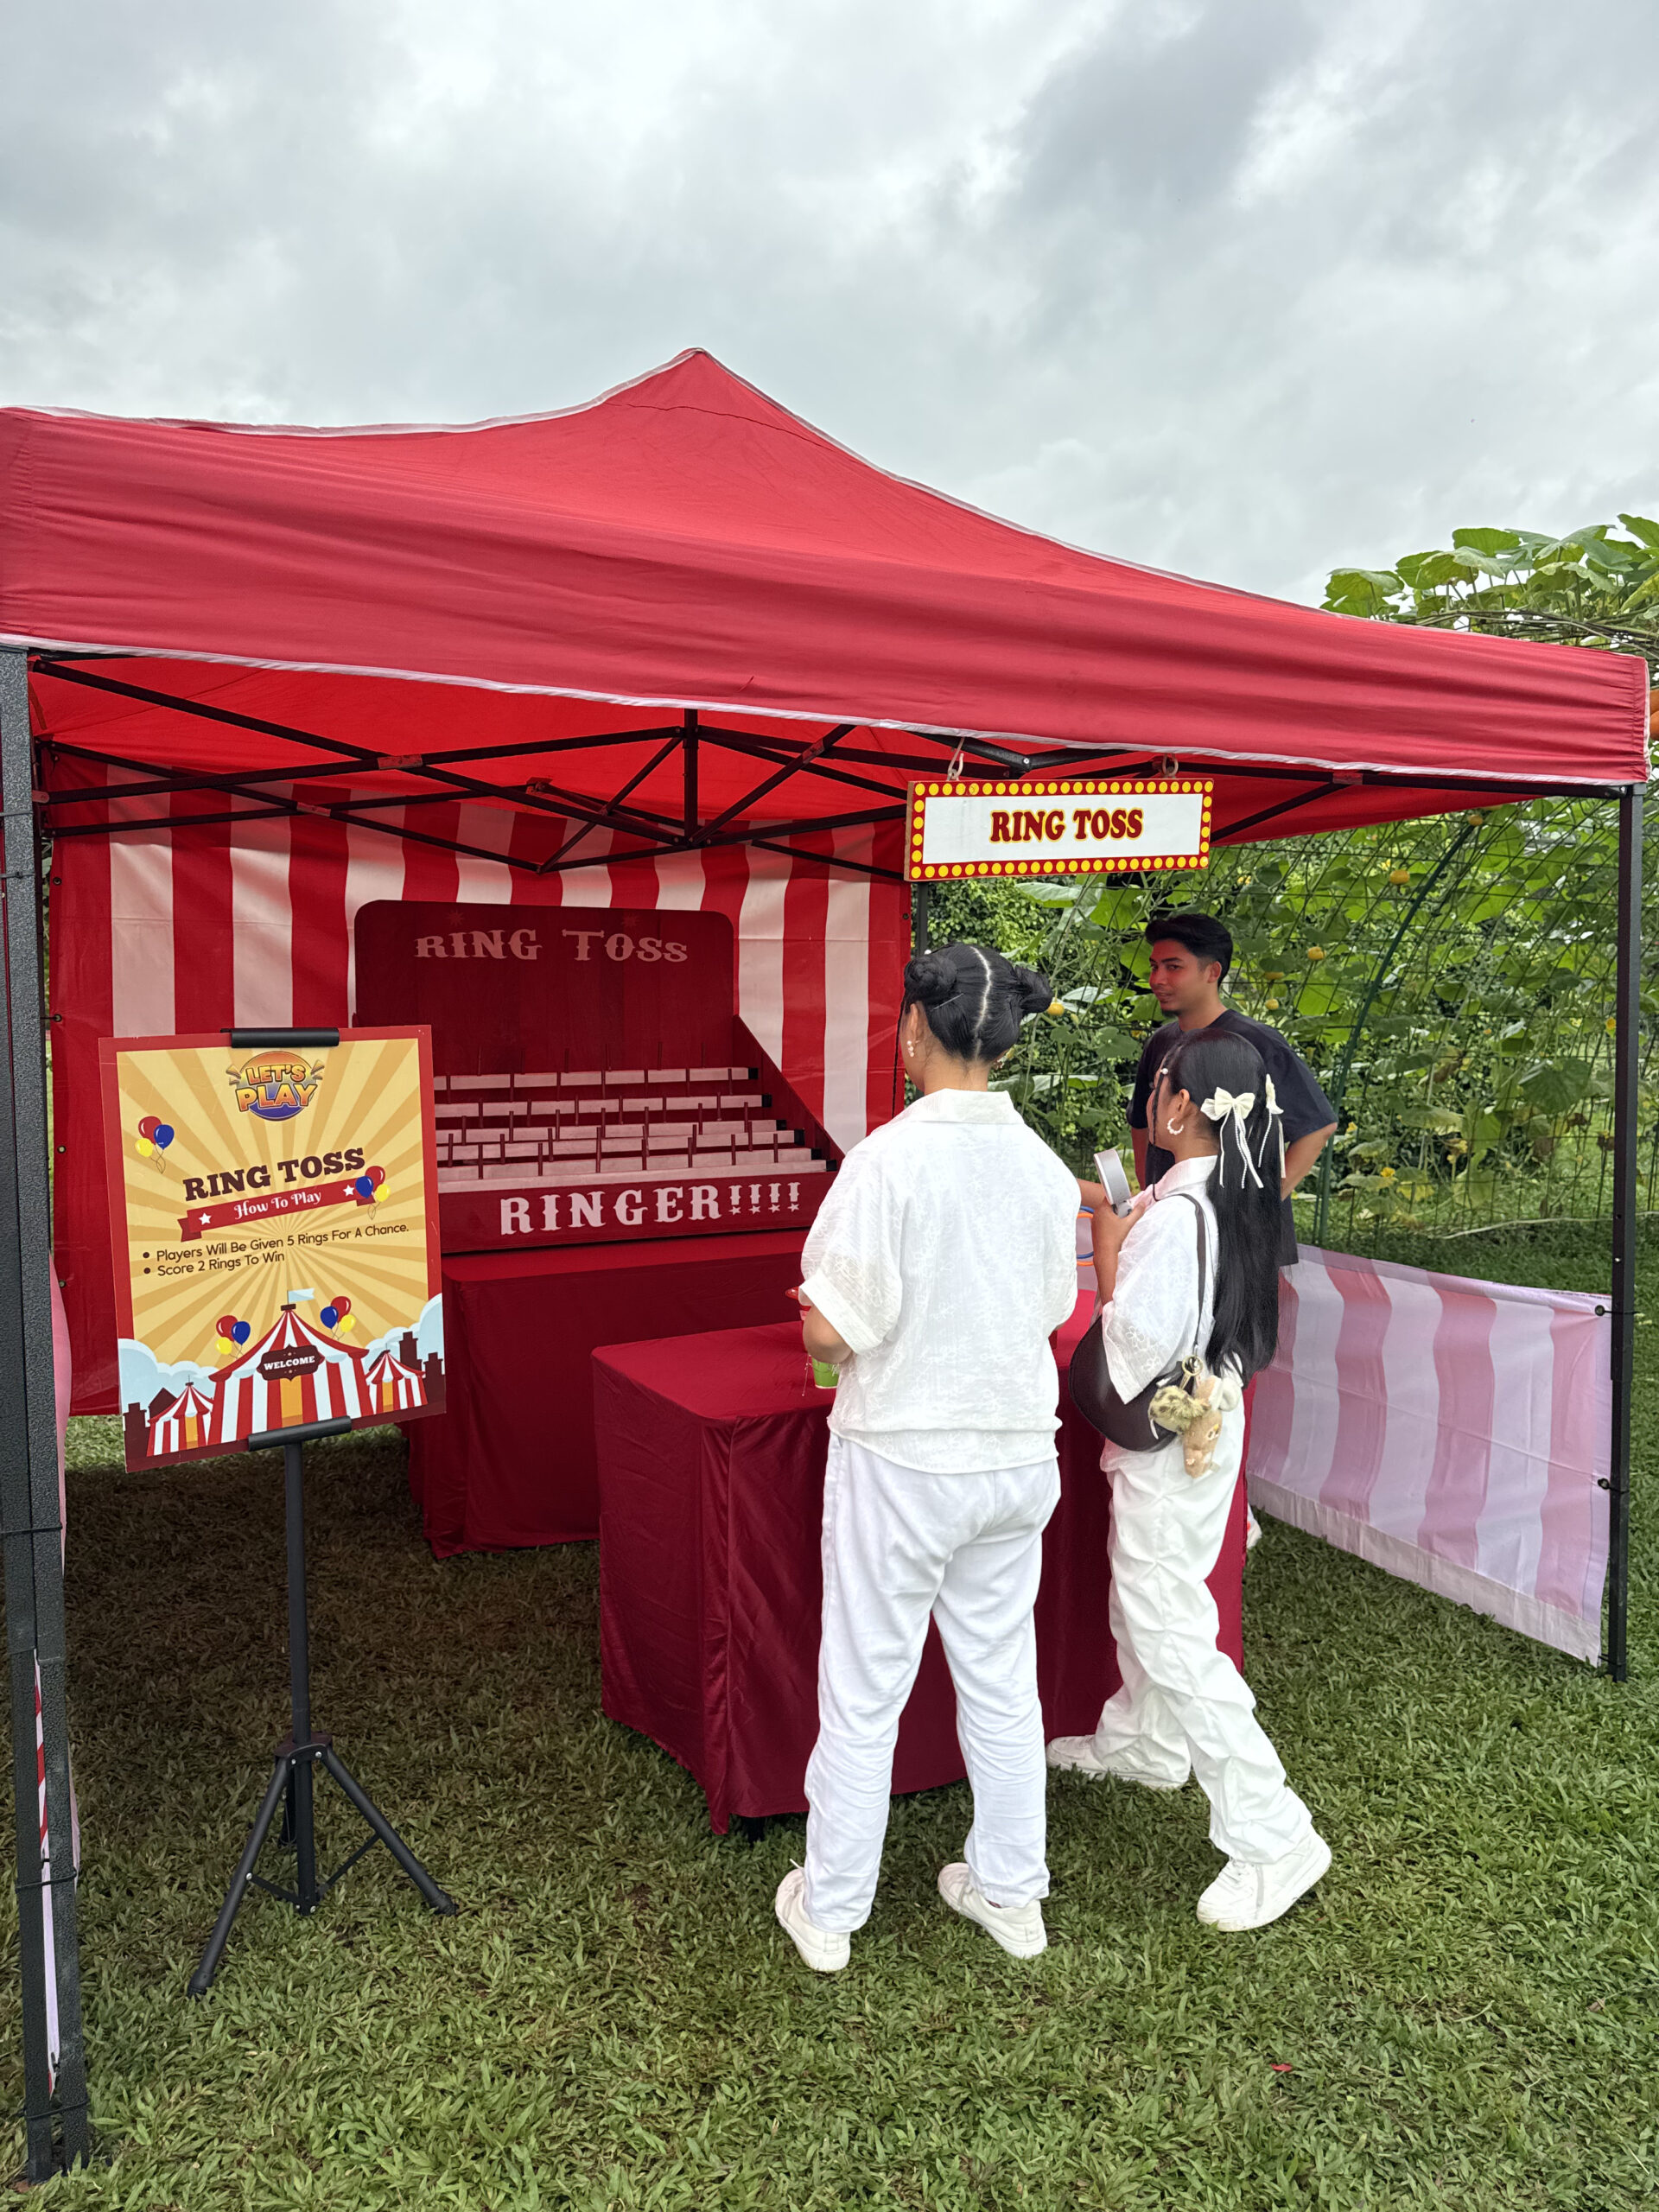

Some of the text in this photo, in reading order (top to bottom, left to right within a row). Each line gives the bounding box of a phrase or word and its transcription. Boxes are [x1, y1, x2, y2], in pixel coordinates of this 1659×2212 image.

[989, 807, 1144, 843] RING TOSS
[414, 928, 689, 963] RING TOSS
[245, 1064, 306, 1085] LET'S
[235, 1083, 318, 1112] PLAY
[182, 1147, 366, 1202] RING TOSS
[233, 1192, 322, 1220] How To Play
[500, 1181, 802, 1236] RINGER!!!!
[156, 1223, 410, 1263] Players Will Be Given 5 Rings For A Chance.
[157, 1251, 285, 1277] Score 2 Rings To Win
[263, 1355, 315, 1370] WELCOME
